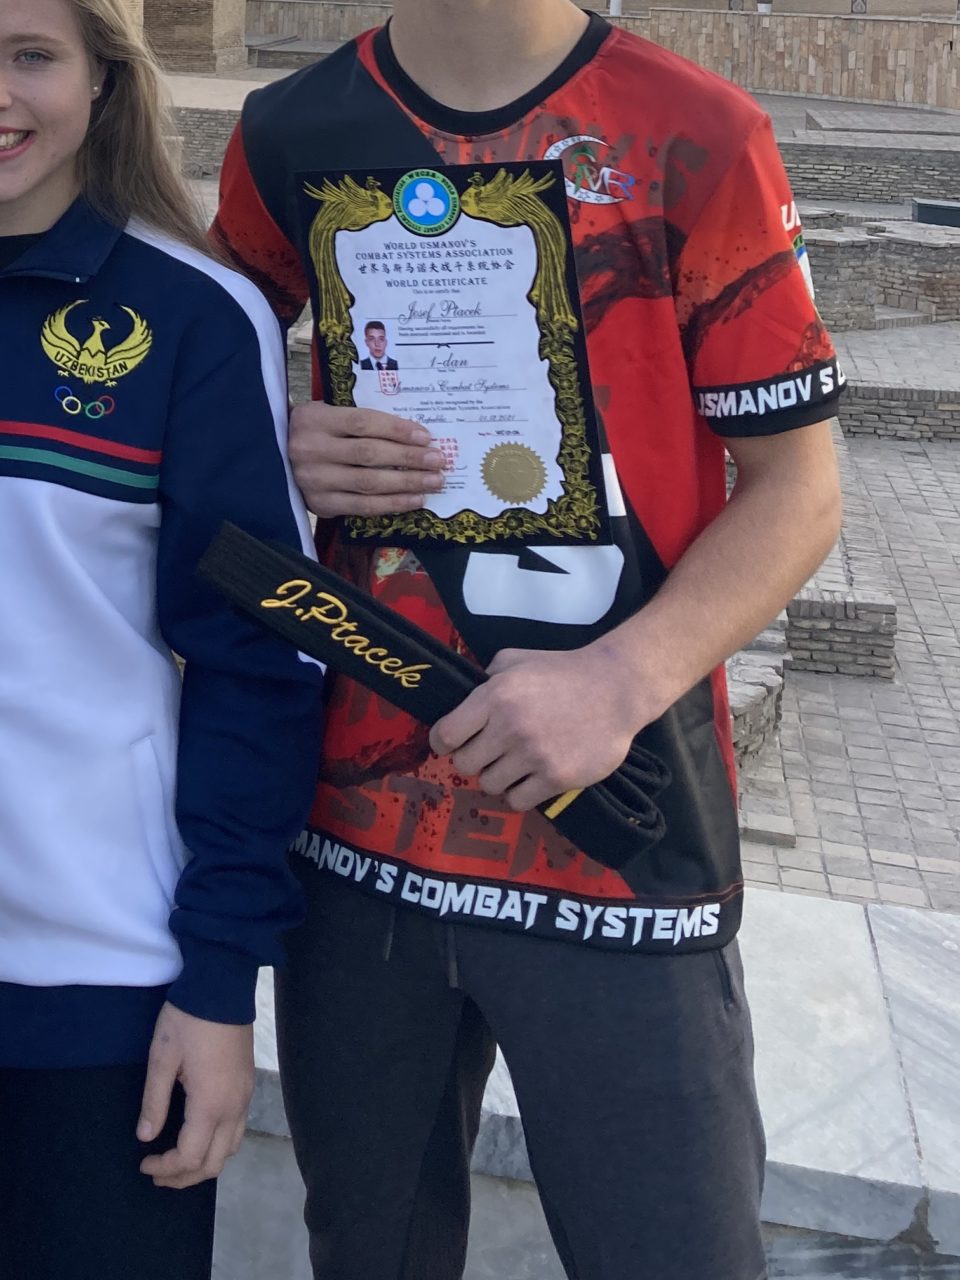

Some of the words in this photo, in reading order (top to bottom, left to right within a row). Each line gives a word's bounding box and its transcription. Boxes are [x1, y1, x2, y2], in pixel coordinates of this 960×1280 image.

[384, 242, 416, 250] WORLD
[420, 239, 477, 249] USMANOV'S
[355, 252, 393, 260] COMBAT
[397, 250, 441, 259] SYSTEMS
[445, 248, 513, 258] ASSOCIATION
[386, 279, 419, 287] WORLD
[422, 277, 488, 286] CERTIFICATE
[398, 300, 436, 325] Josef
[54, 351, 129, 378] UZBEKISTAN
[430, 353, 468, 368] 1-dan
[400, 876, 548, 930] COMBAT
[555, 898, 721, 946] SYSTEMS
